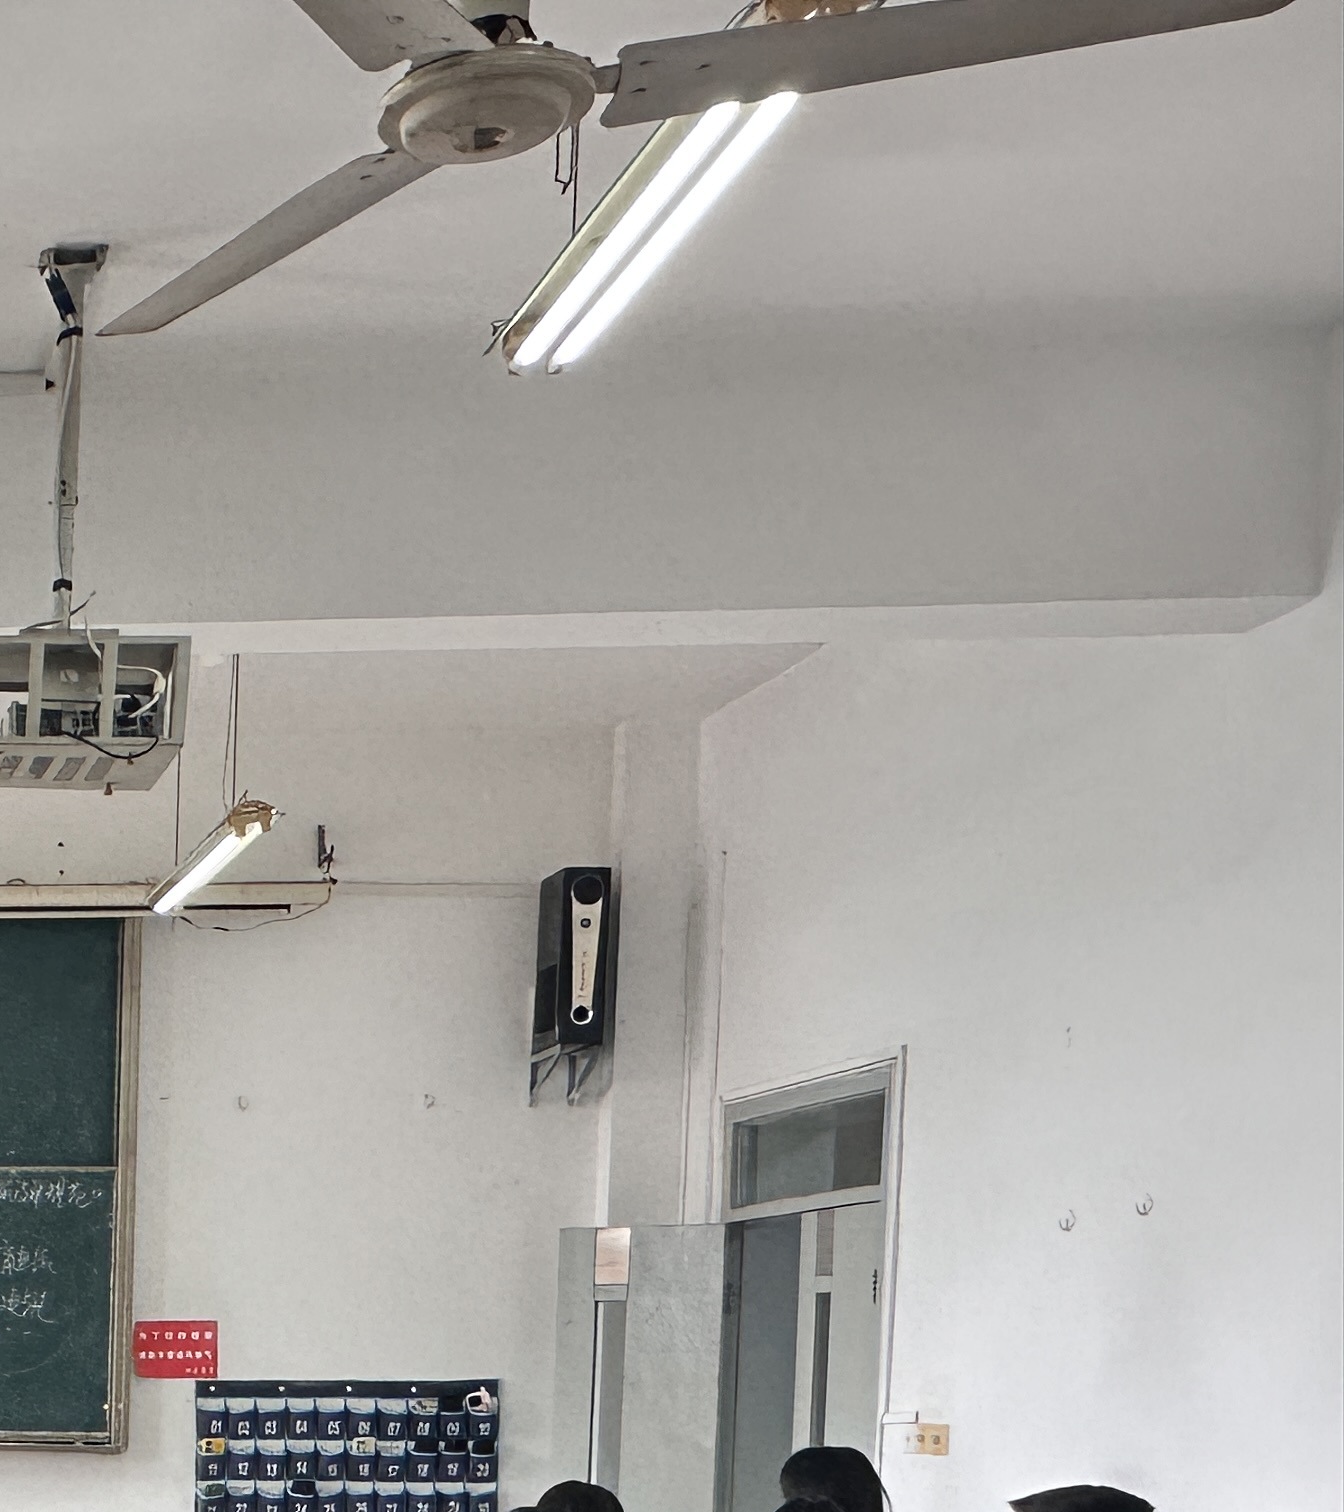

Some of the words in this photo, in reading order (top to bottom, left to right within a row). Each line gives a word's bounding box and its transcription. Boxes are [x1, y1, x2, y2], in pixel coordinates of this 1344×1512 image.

[210, 1420, 222, 1434] 01
[264, 1420, 277, 1435] 03
[327, 1420, 342, 1435] 05
[387, 1422, 401, 1436] 07
